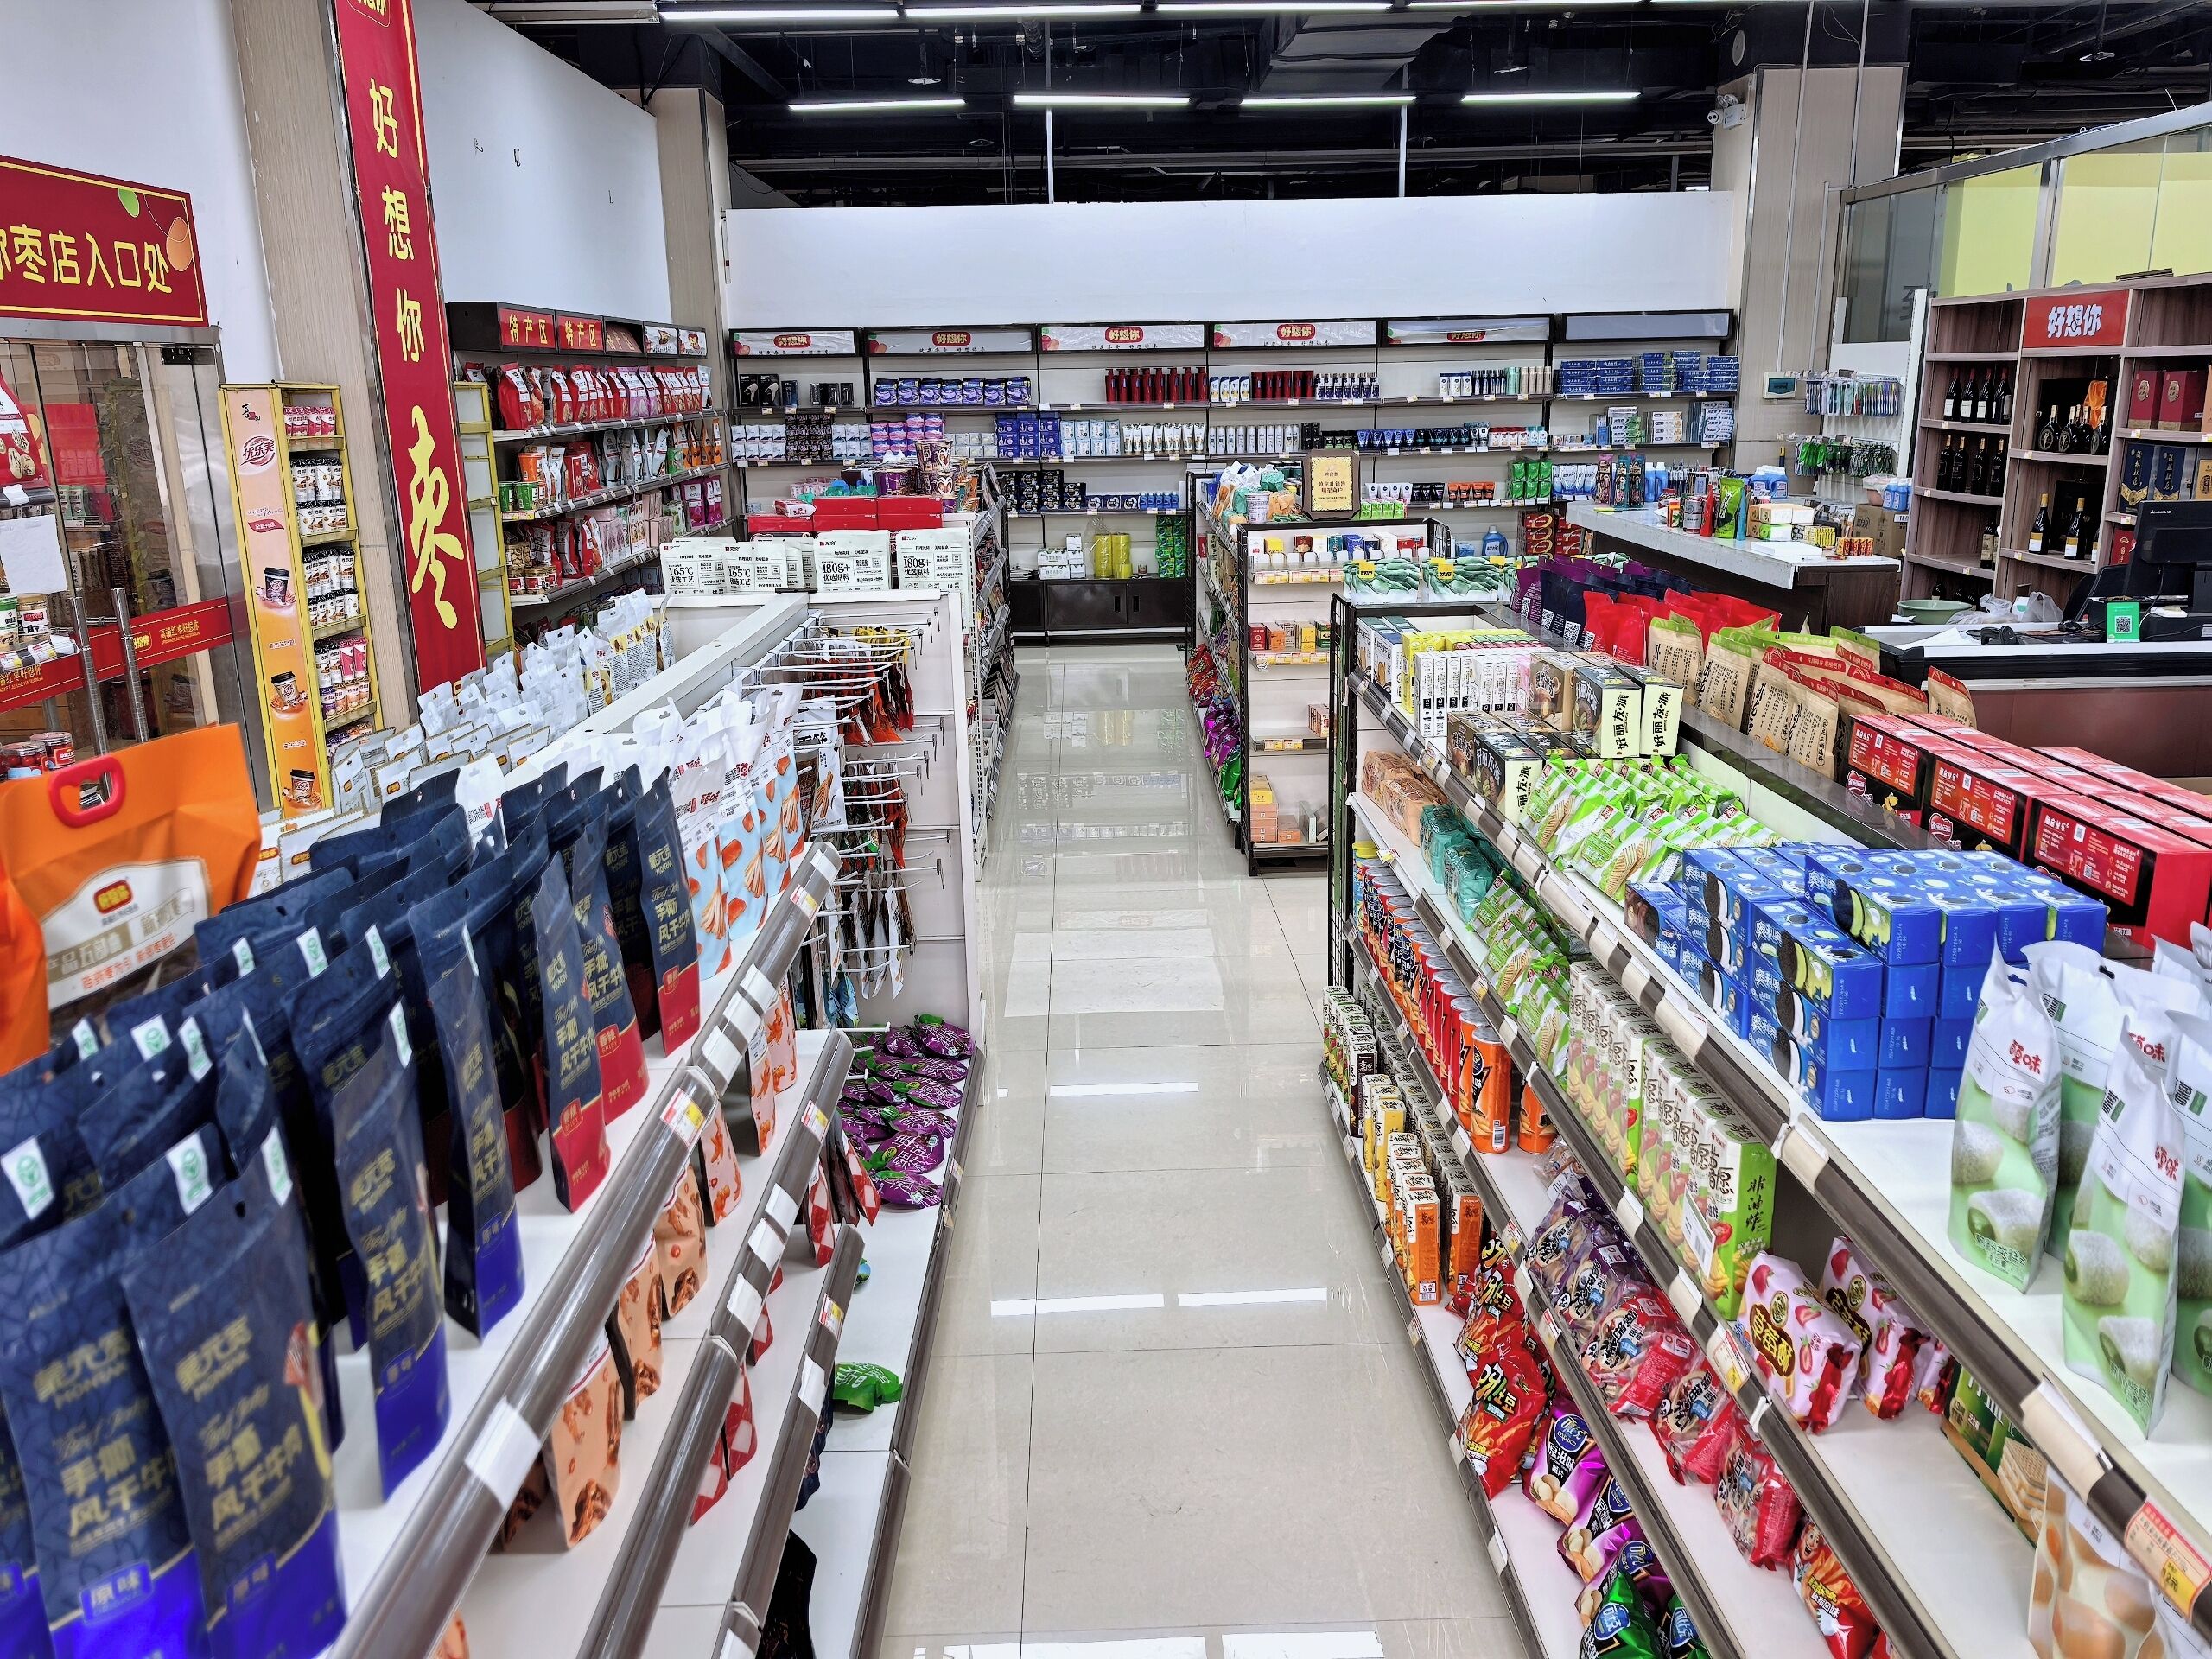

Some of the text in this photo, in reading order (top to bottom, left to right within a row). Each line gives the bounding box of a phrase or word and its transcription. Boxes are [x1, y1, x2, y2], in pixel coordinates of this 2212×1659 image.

[369, 78, 425, 363] 好想你
[509, 313, 548, 344] 特产区
[564, 320, 597, 347] 特产区
[1109, 329, 1141, 341] 好想你
[1281, 326, 1313, 338] 好想你
[2046, 303, 2104, 340] 好想你
[778, 335, 808, 346] 好想你
[936, 334, 968, 345] 好想你
[655, 897, 677, 922] 手撕
[584, 951, 609, 983] 手撕
[556, 1017, 579, 1047] 手撕
[599, 1028, 617, 1045] 香辣
[61, 1434, 136, 1500] 手撕
[205, 1422, 262, 1489] 手撕
[1548, 1442, 1576, 1471] 原滋味
[90, 1569, 143, 1607] 原味
